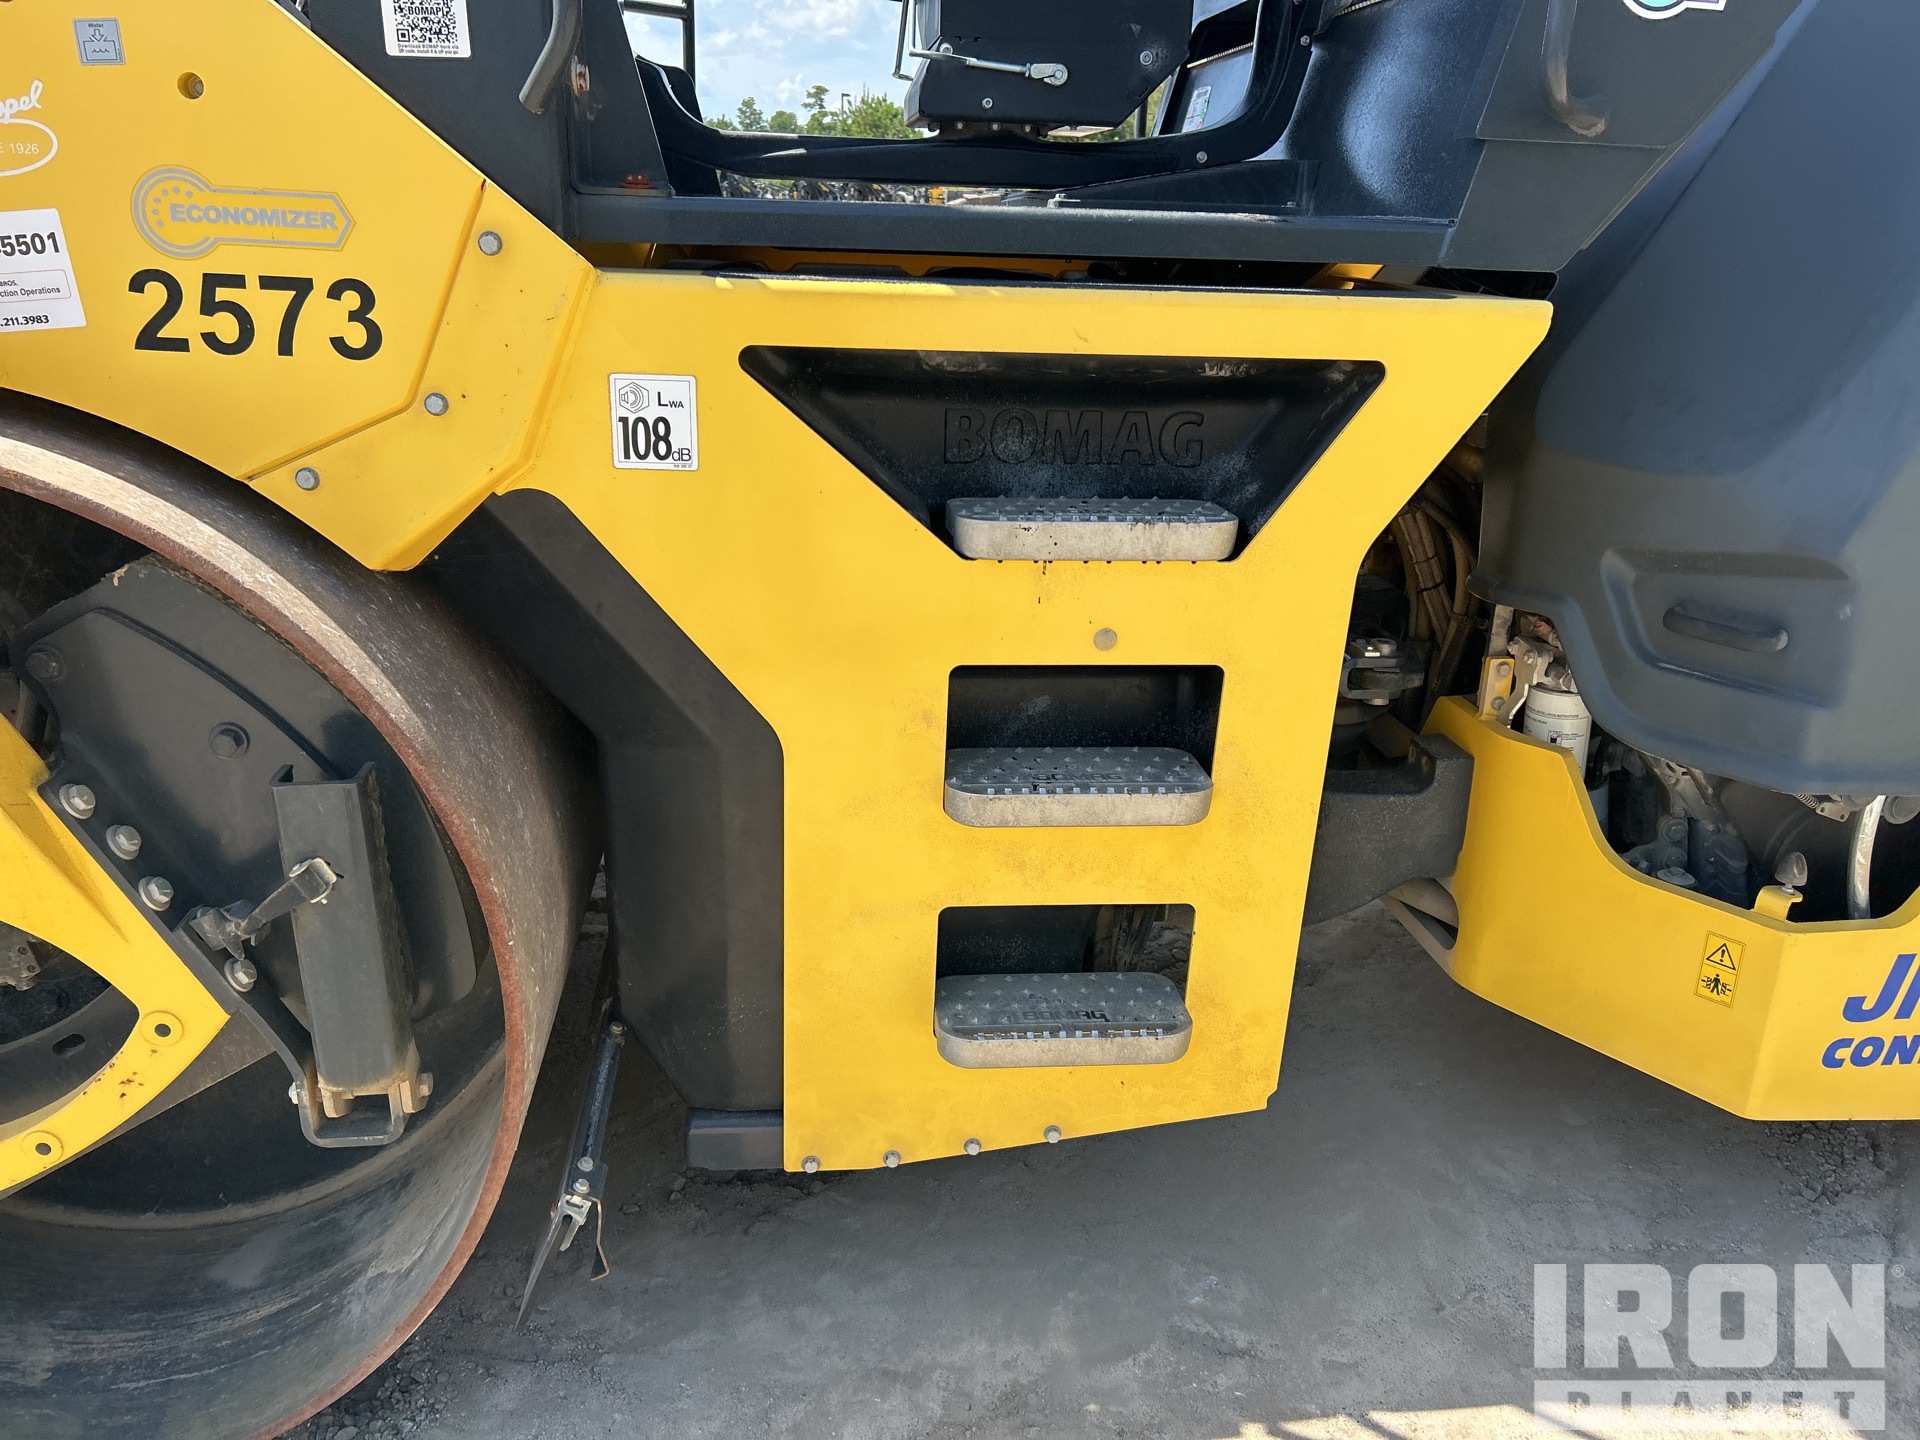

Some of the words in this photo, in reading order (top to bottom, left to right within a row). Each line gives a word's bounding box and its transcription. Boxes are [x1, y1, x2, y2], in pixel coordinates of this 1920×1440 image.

[9, 143, 40, 155] 1926
[169, 202, 339, 231] ECONOMIZER
[0, 231, 60, 257] 5501
[0, 288, 19, 298] ction
[20, 286, 61, 297] Operations
[0, 314, 50, 327] .211.3983
[127, 268, 384, 362] 2573
[943, 408, 1204, 468] BOMAG
[1821, 1034, 1920, 1069] CON
